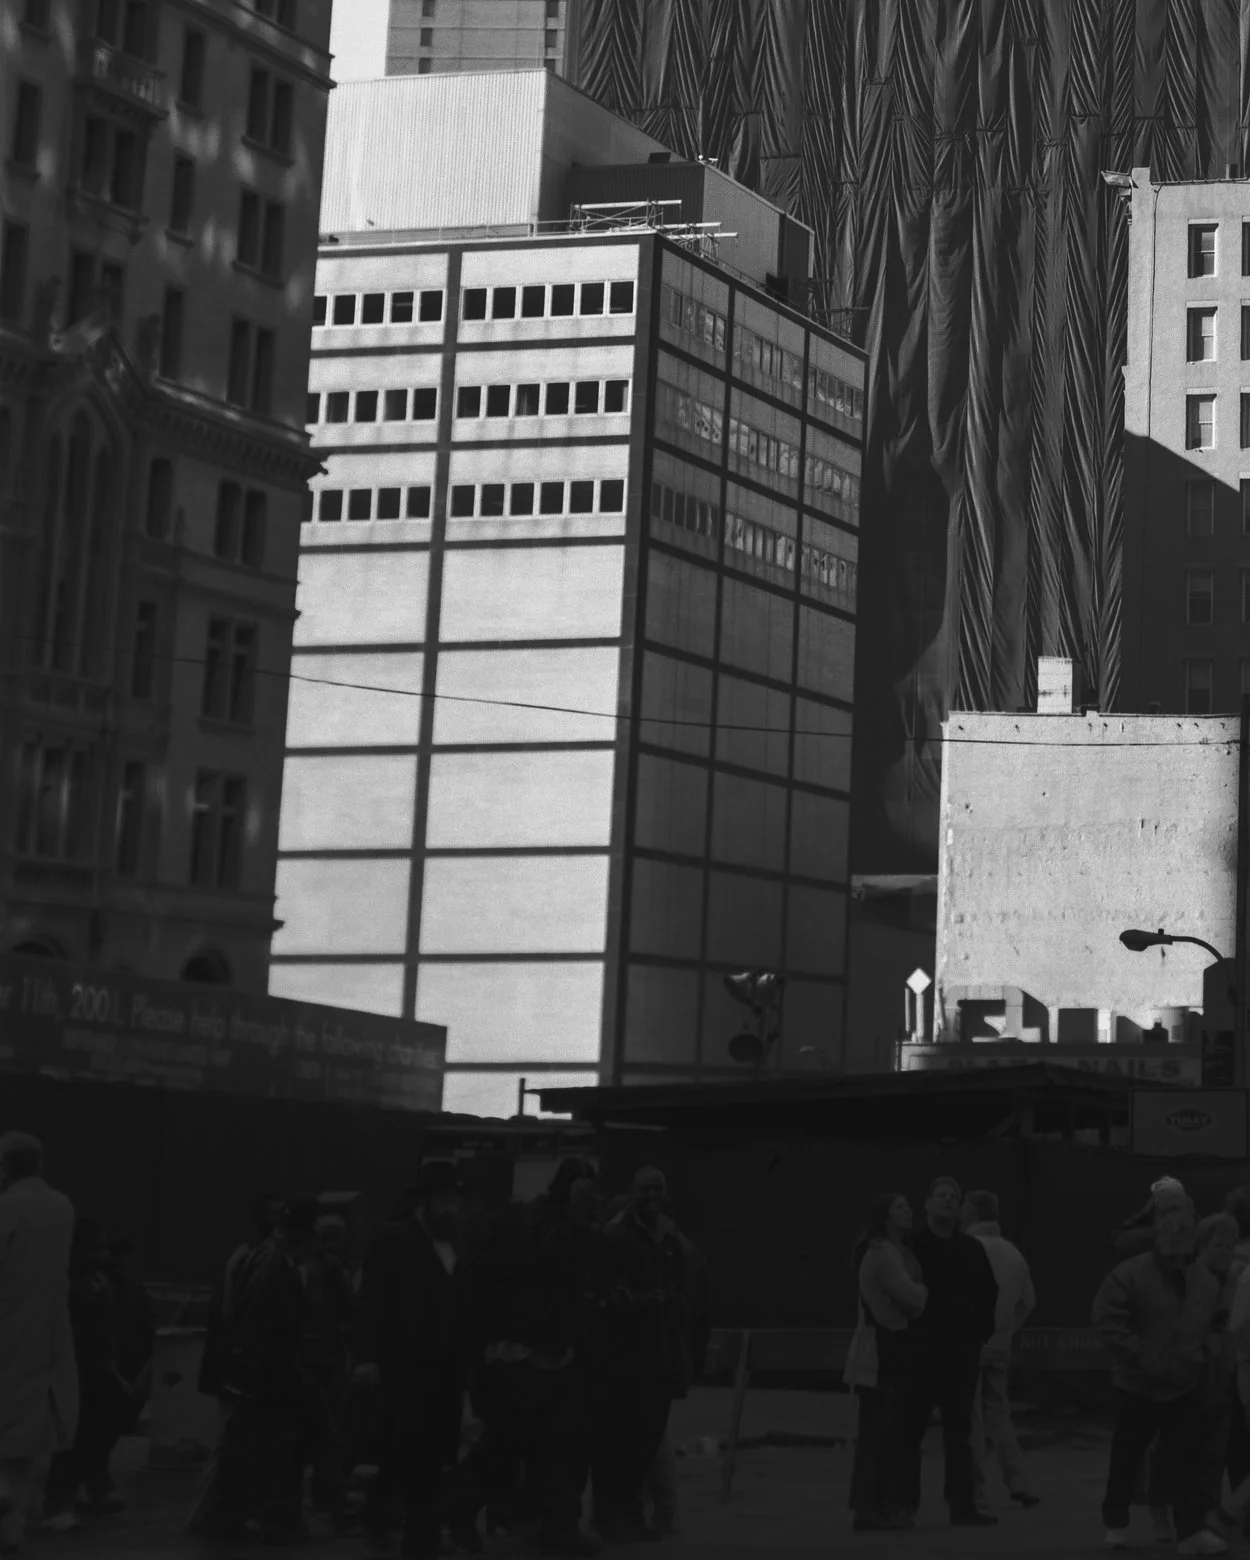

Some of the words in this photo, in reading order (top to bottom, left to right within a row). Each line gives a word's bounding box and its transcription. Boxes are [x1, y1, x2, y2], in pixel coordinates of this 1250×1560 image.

[131, 993, 186, 1034] Please
[189, 996, 227, 1048] help
[229, 1007, 290, 1058] through
[321, 1022, 384, 1070] following
[1077, 1058, 1181, 1079] NAILS
